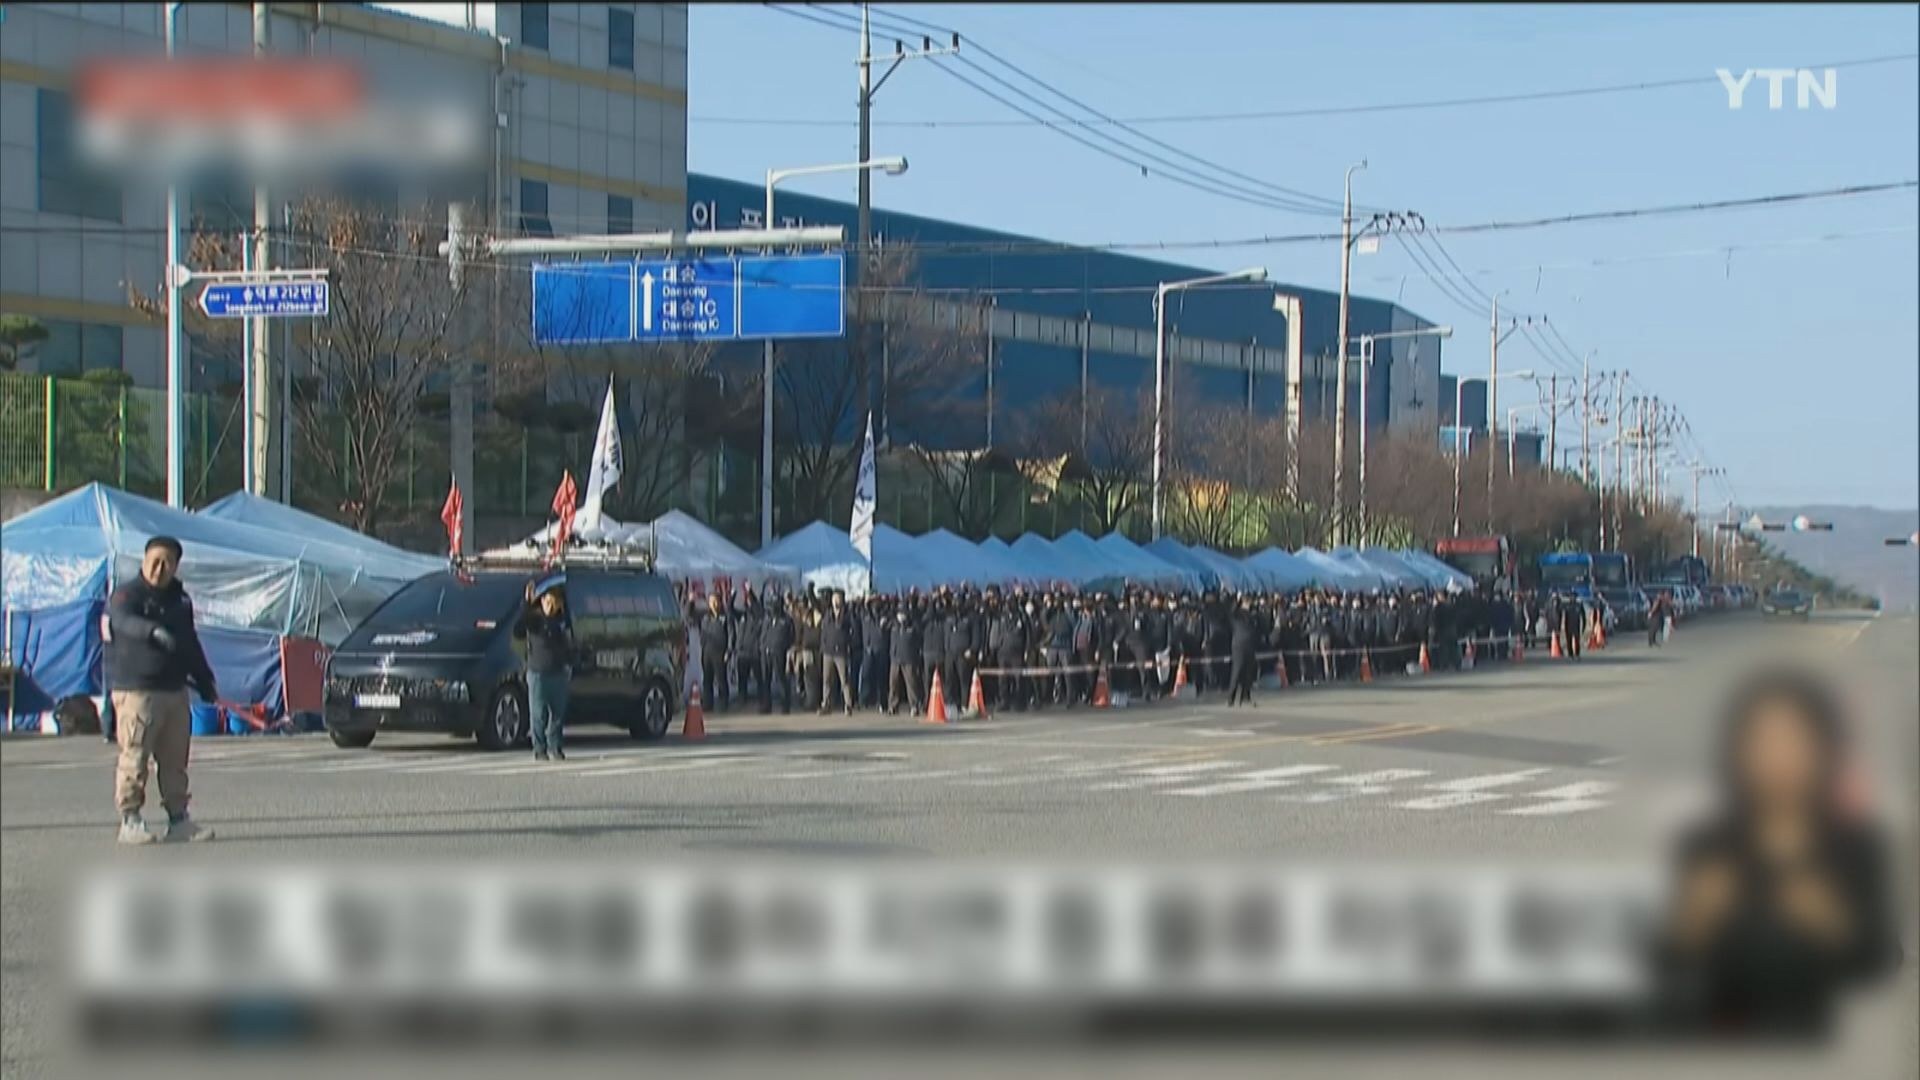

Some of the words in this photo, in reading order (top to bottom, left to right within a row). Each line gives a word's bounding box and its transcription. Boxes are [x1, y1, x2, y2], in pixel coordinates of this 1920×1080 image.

[663, 264, 696, 284] 대송
[663, 286, 708, 299] Daesong
[663, 319, 707, 332] Daesong
